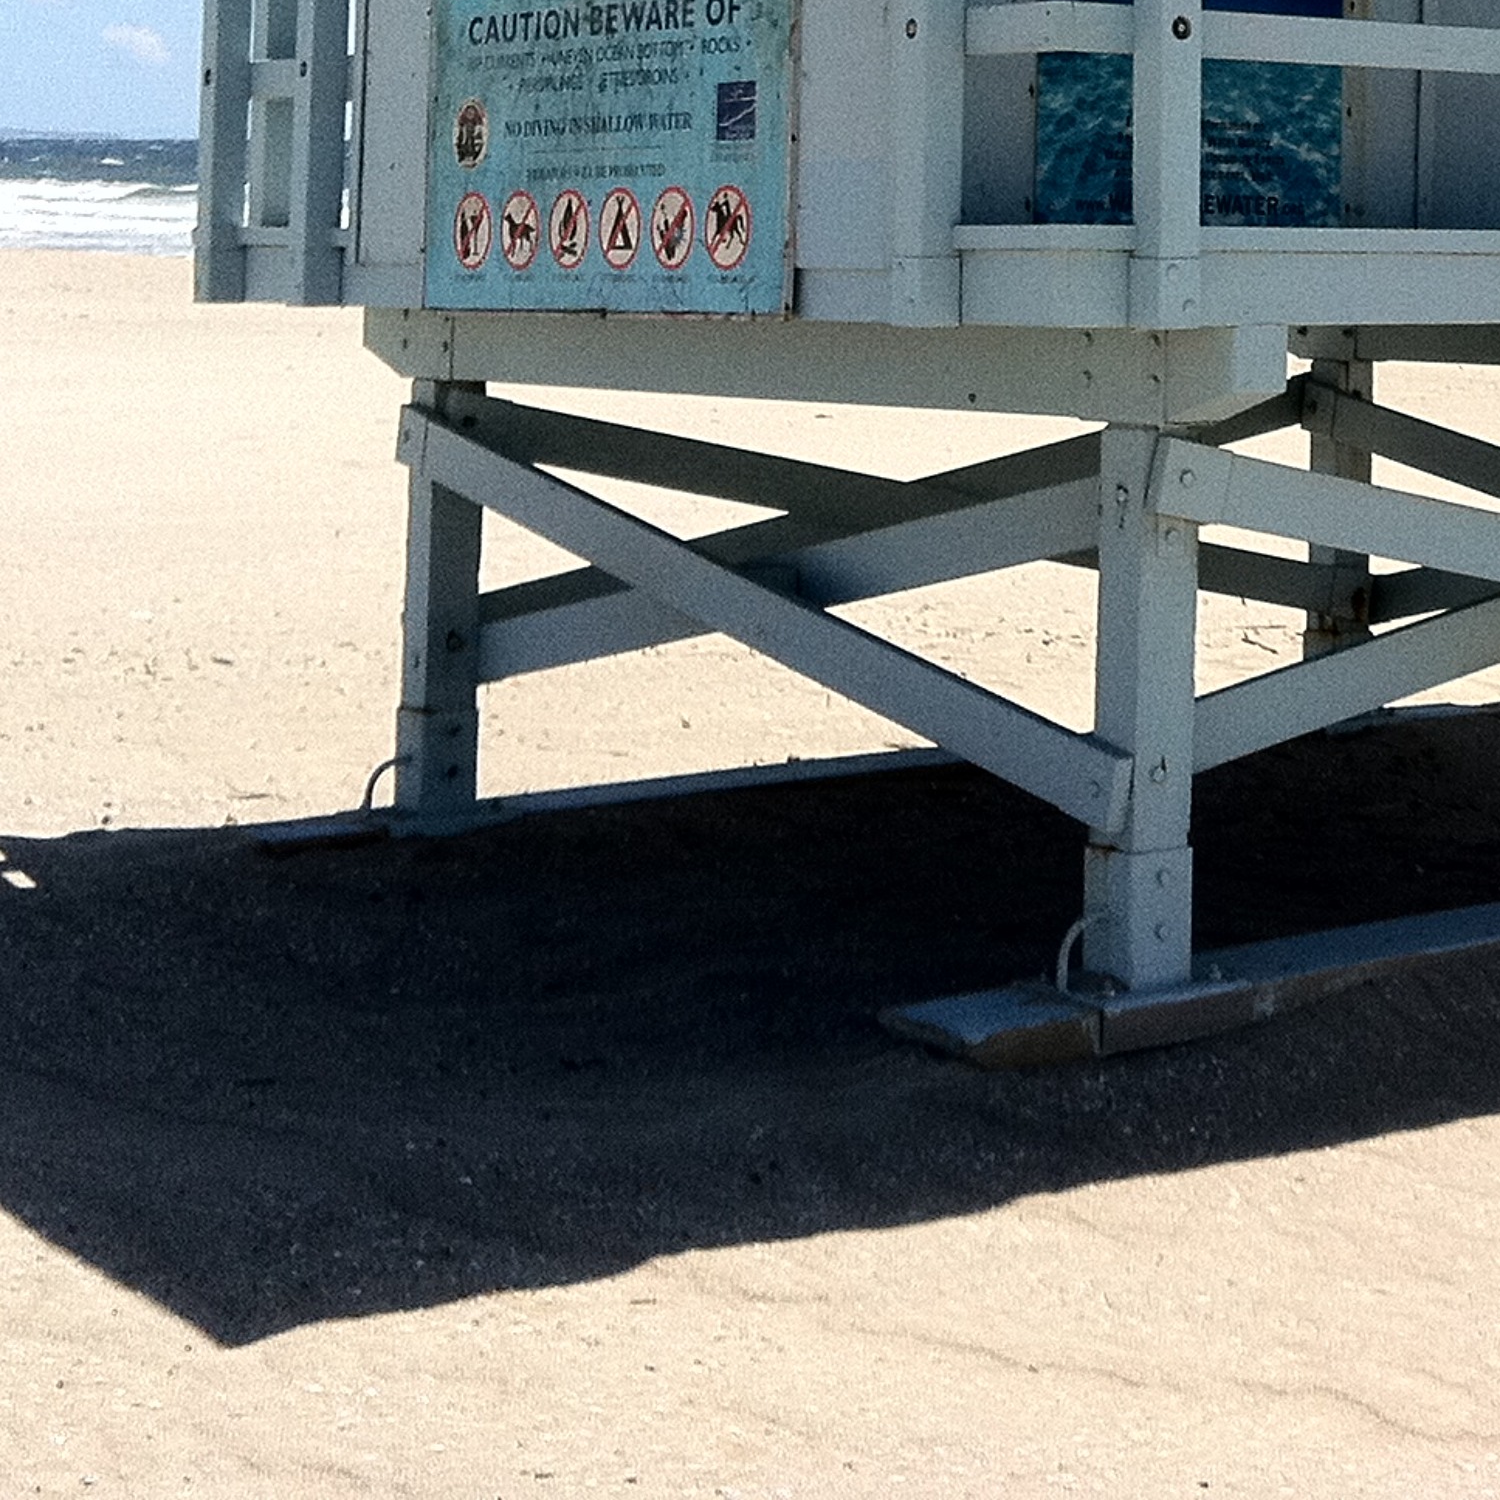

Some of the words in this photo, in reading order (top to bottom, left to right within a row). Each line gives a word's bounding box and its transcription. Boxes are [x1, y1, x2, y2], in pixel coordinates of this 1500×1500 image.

[469, 9, 579, 45] CAUTION
[504, 120, 523, 139] NO
[523, 118, 566, 138] DIVING
[584, 113, 644, 135] SHALLOW
[649, 111, 692, 132] WATER
